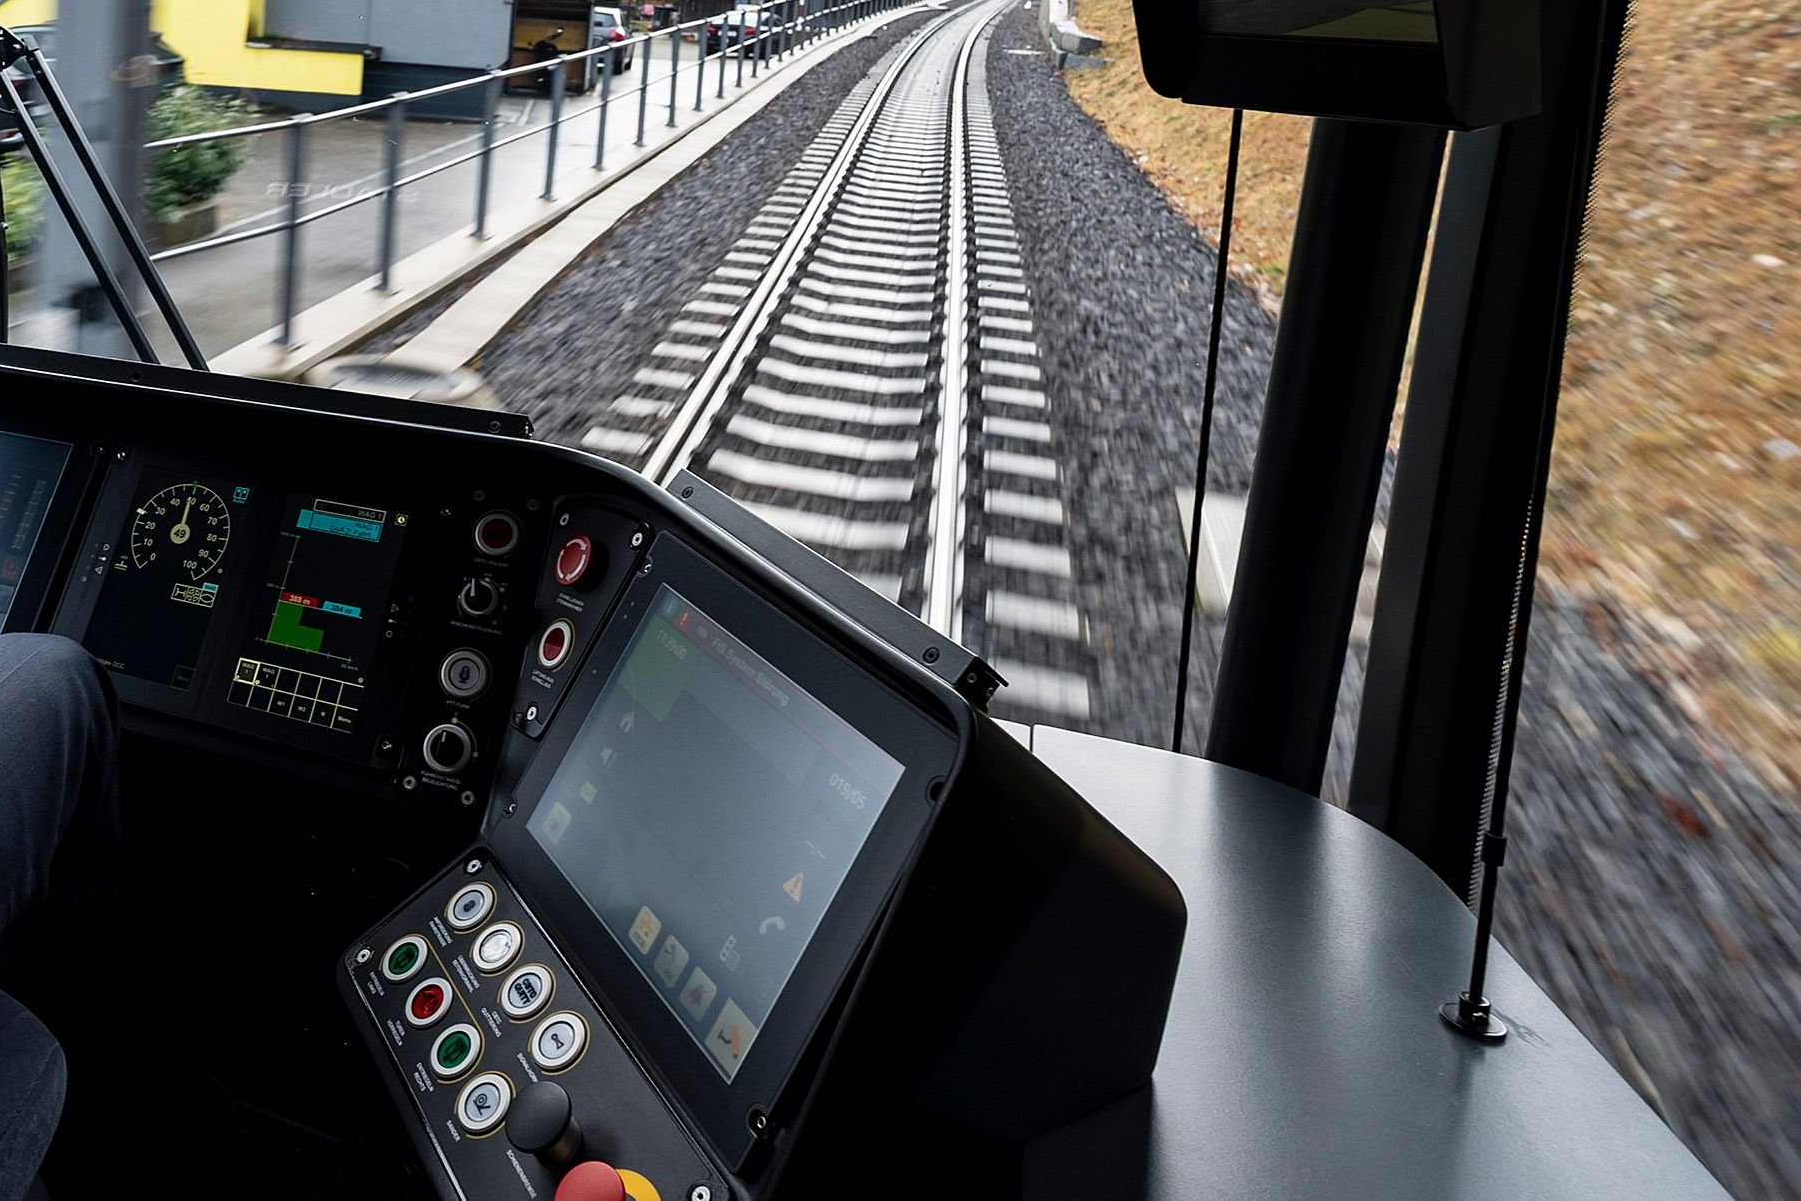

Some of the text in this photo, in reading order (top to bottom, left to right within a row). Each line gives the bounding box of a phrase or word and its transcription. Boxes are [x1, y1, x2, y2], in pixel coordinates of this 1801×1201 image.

[169, 497, 181, 507] 40
[186, 497, 196, 506] 50
[155, 507, 166, 516] 30
[199, 503, 210, 512] 60
[207, 516, 217, 525] 70
[145, 521, 156, 530] 20
[173, 528, 186, 539] 49
[207, 533, 217, 543] 80
[143, 538, 153, 547] 10
[150, 552, 156, 561] 0
[199, 549, 209, 558] 90
[183, 560, 197, 569] 100
